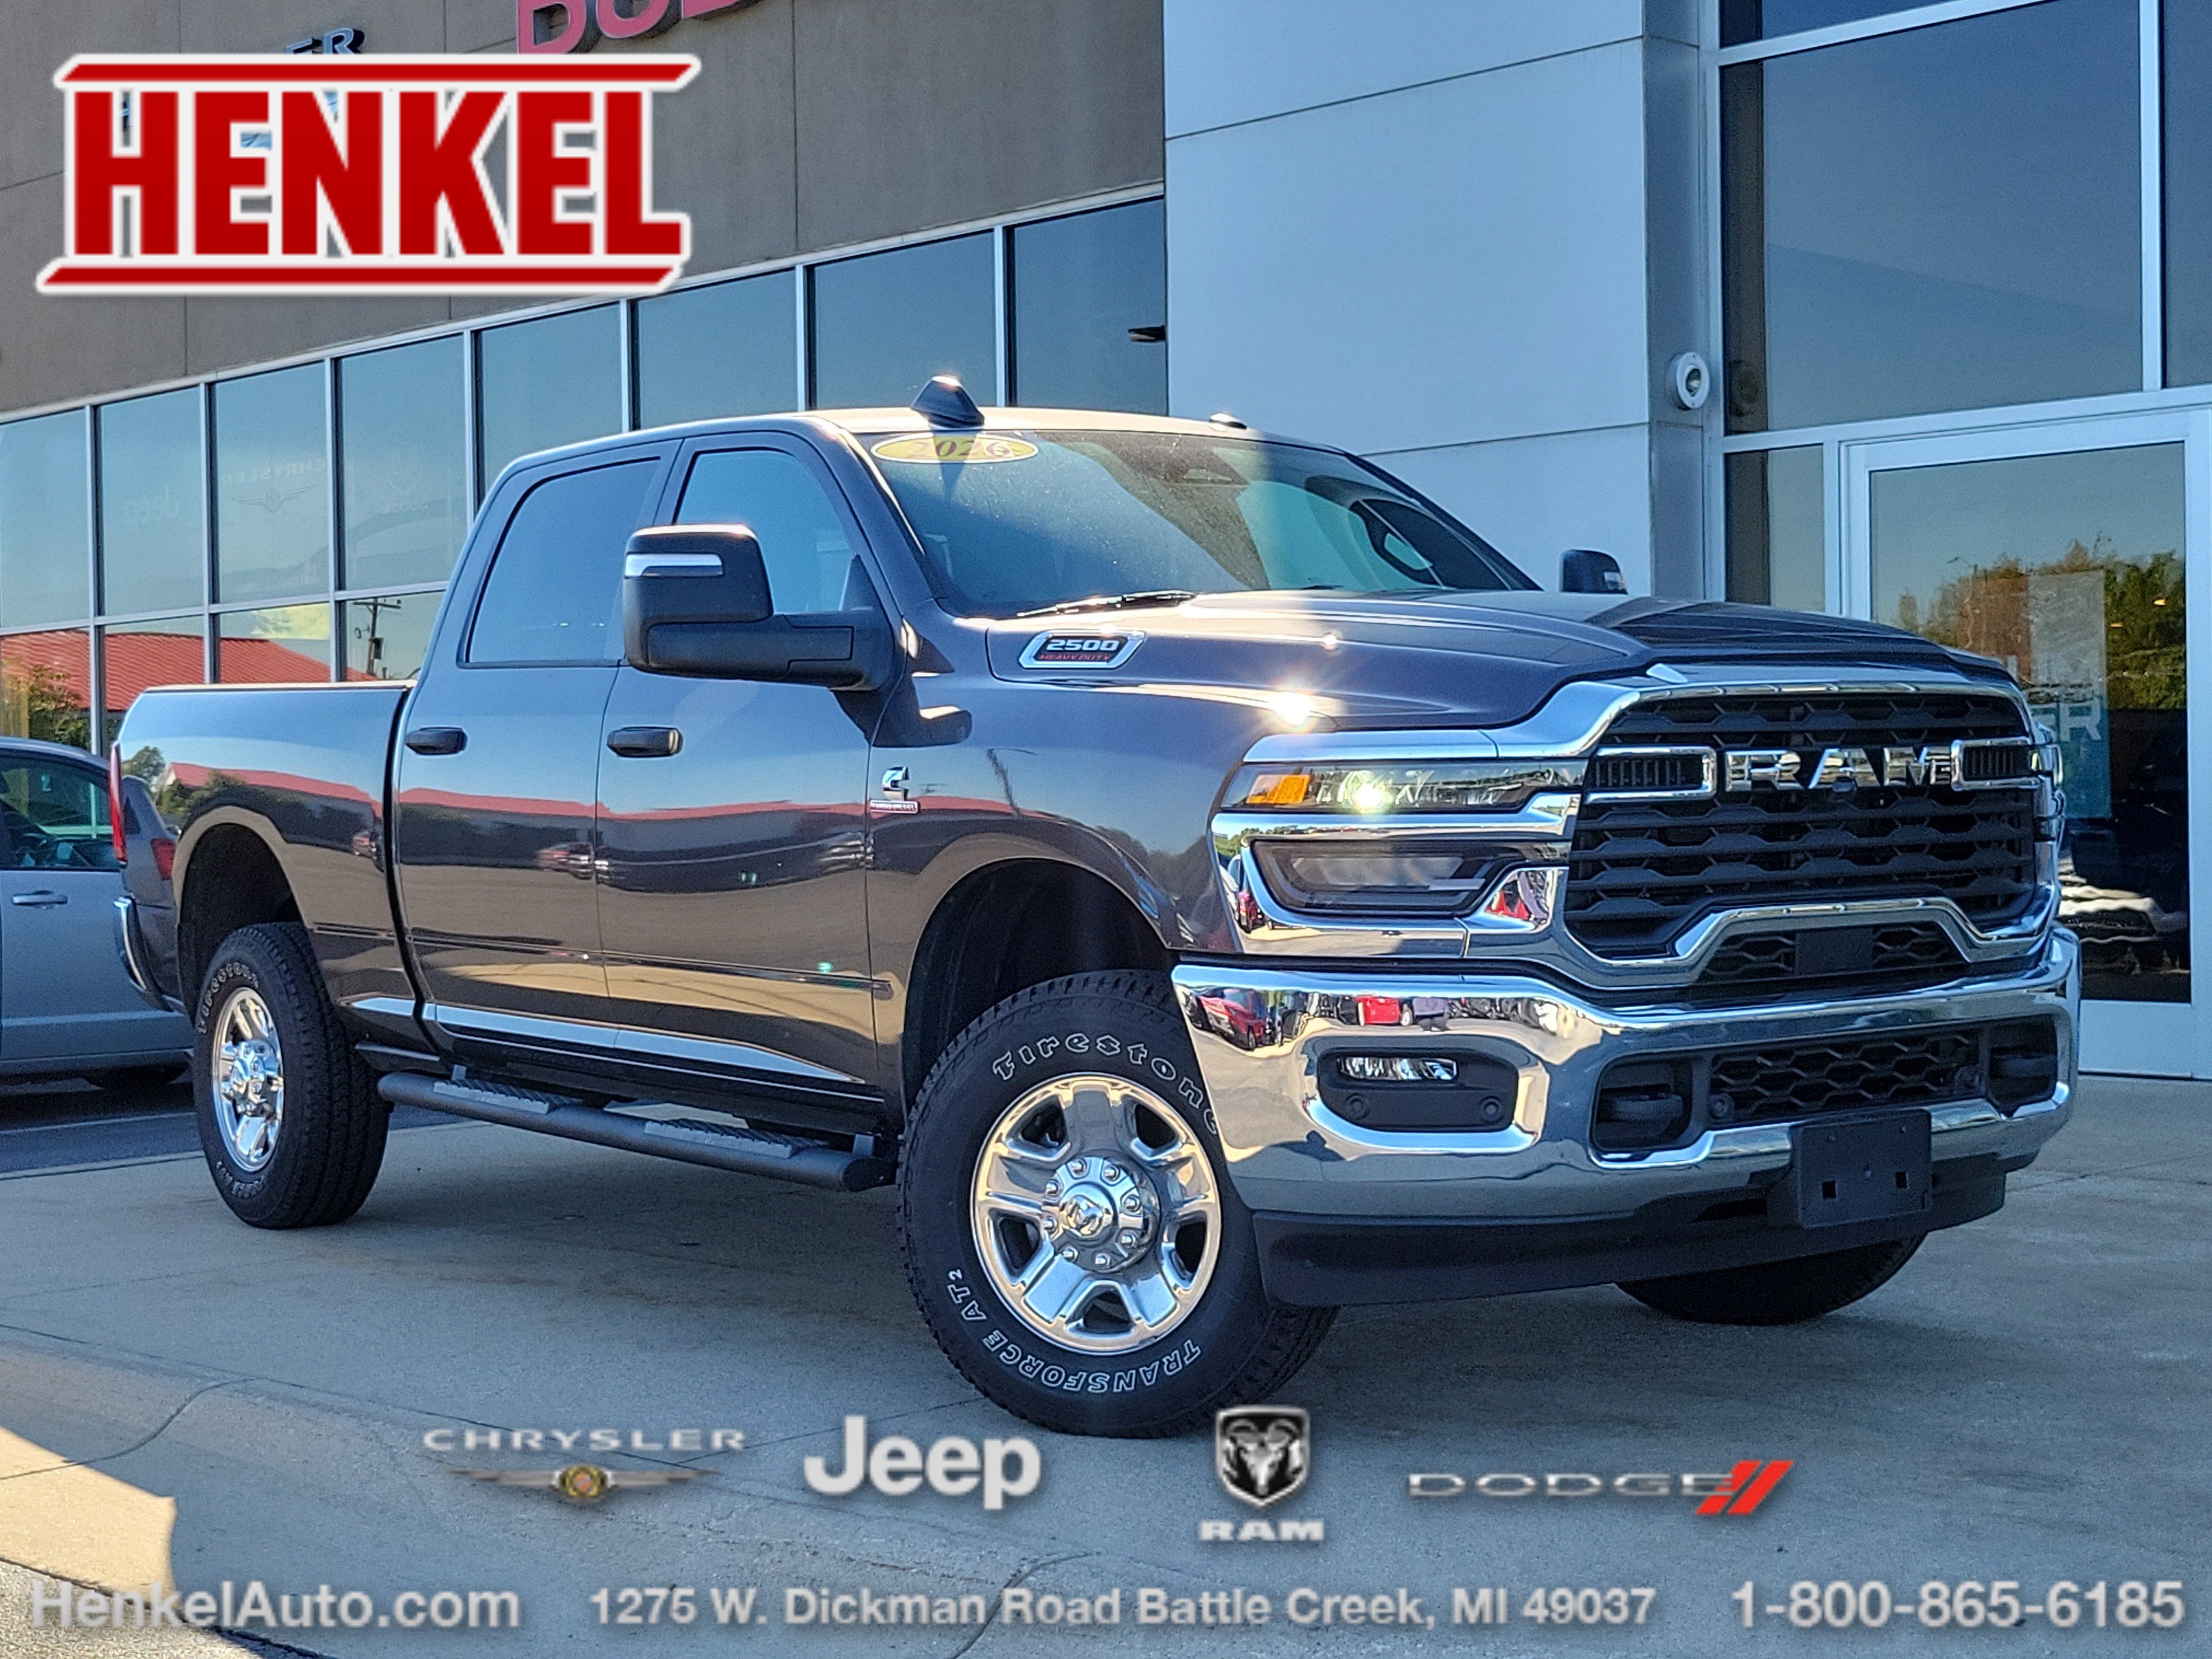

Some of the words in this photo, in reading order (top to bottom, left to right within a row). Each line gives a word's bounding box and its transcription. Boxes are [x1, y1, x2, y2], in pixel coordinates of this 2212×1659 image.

[517, 0, 745, 54] DO
[1046, 639, 1120, 651] 2500
[1725, 746, 1951, 792] RAM
[981, 1329, 1201, 1393] TRANSFORCE
